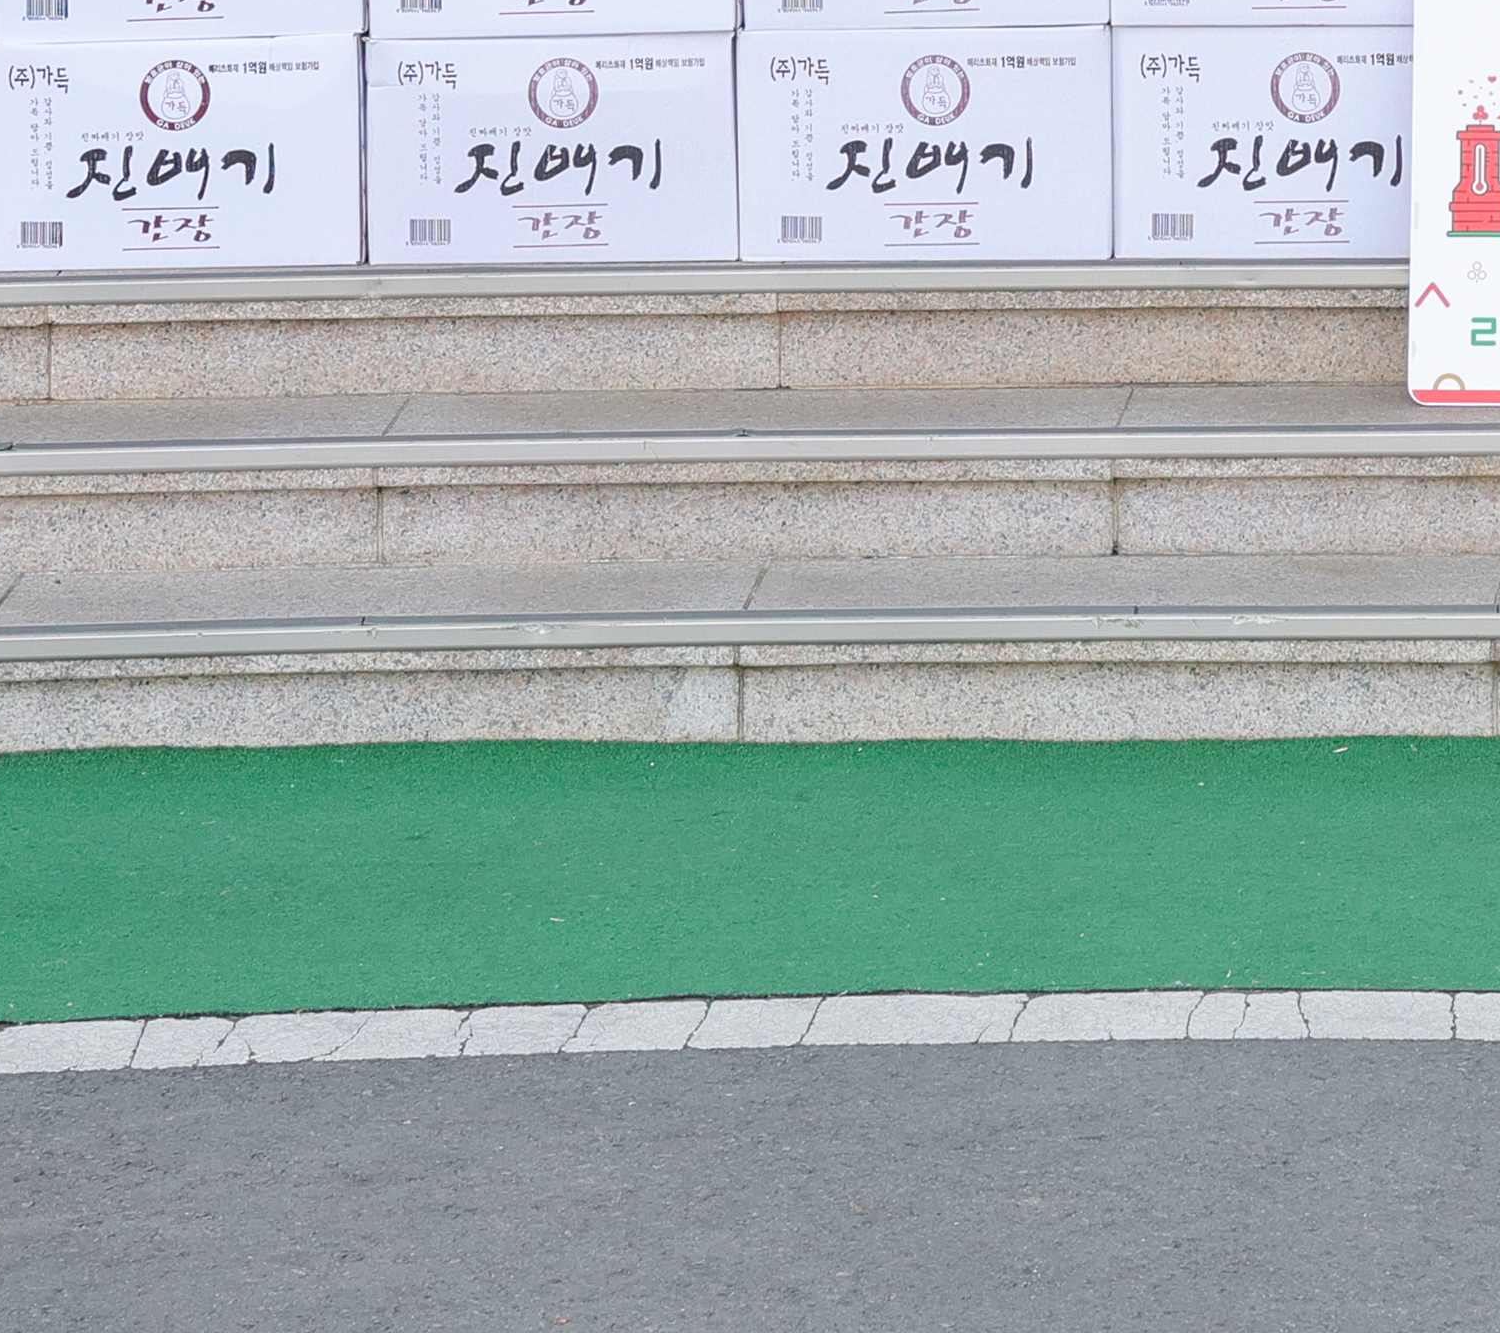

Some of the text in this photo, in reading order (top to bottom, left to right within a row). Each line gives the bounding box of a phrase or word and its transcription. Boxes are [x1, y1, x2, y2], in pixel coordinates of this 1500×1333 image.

[7, 65, 70, 94] (주)가득
[396, 60, 458, 90] (주)가득
[769, 56, 830, 85] (주)가득
[1139, 53, 1202, 83] (주)가득
[66, 143, 275, 201] 진배기
[454, 140, 660, 195] 진배기
[826, 137, 1033, 194] 진배기
[1197, 134, 1401, 191] 진배기
[127, 214, 213, 244] 간장
[513, 208, 597, 236] 간장
[886, 208, 971, 237] 간장
[1256, 204, 1339, 232] 간장
